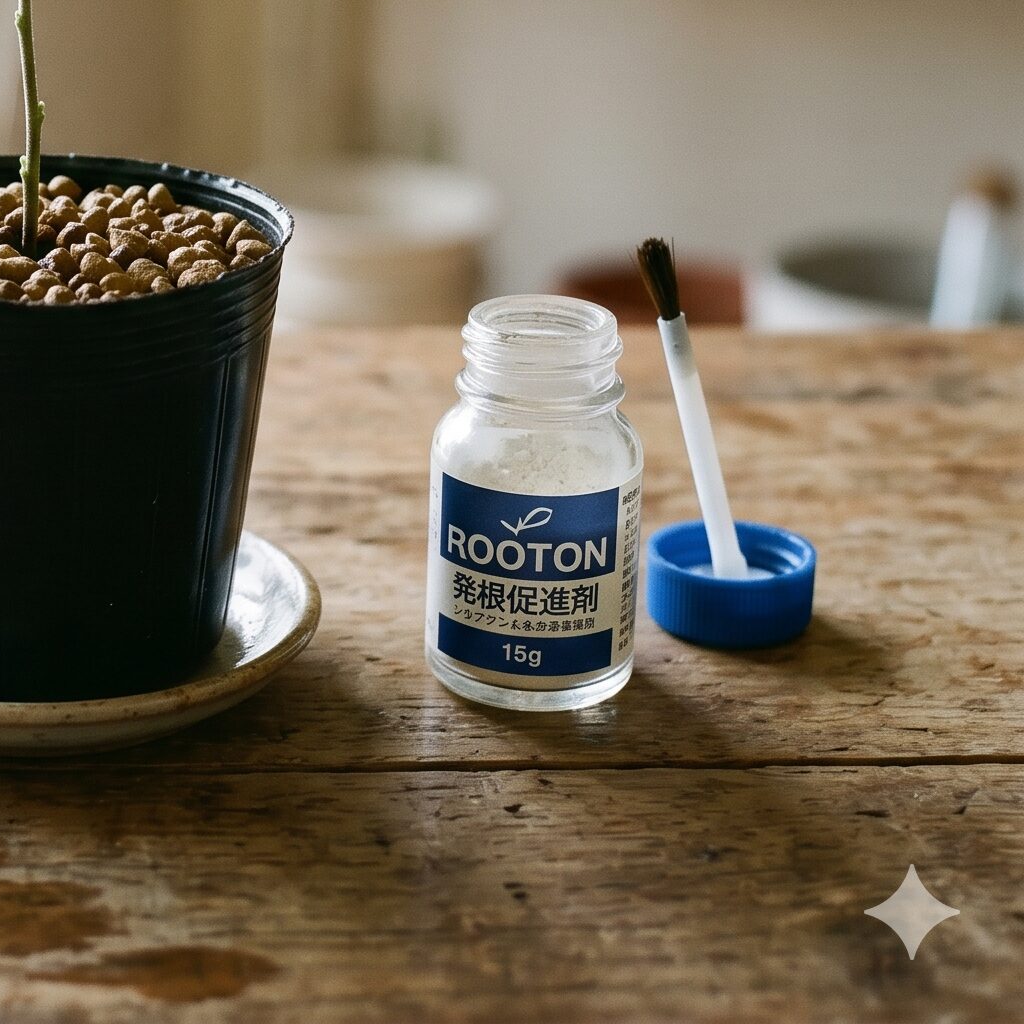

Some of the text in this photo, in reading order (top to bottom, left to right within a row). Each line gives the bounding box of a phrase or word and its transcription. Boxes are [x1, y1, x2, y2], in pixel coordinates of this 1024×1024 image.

[447, 524, 607, 573] ROOTON
[452, 571, 599, 617] 発根促進剤
[502, 643, 542, 667] 15g
